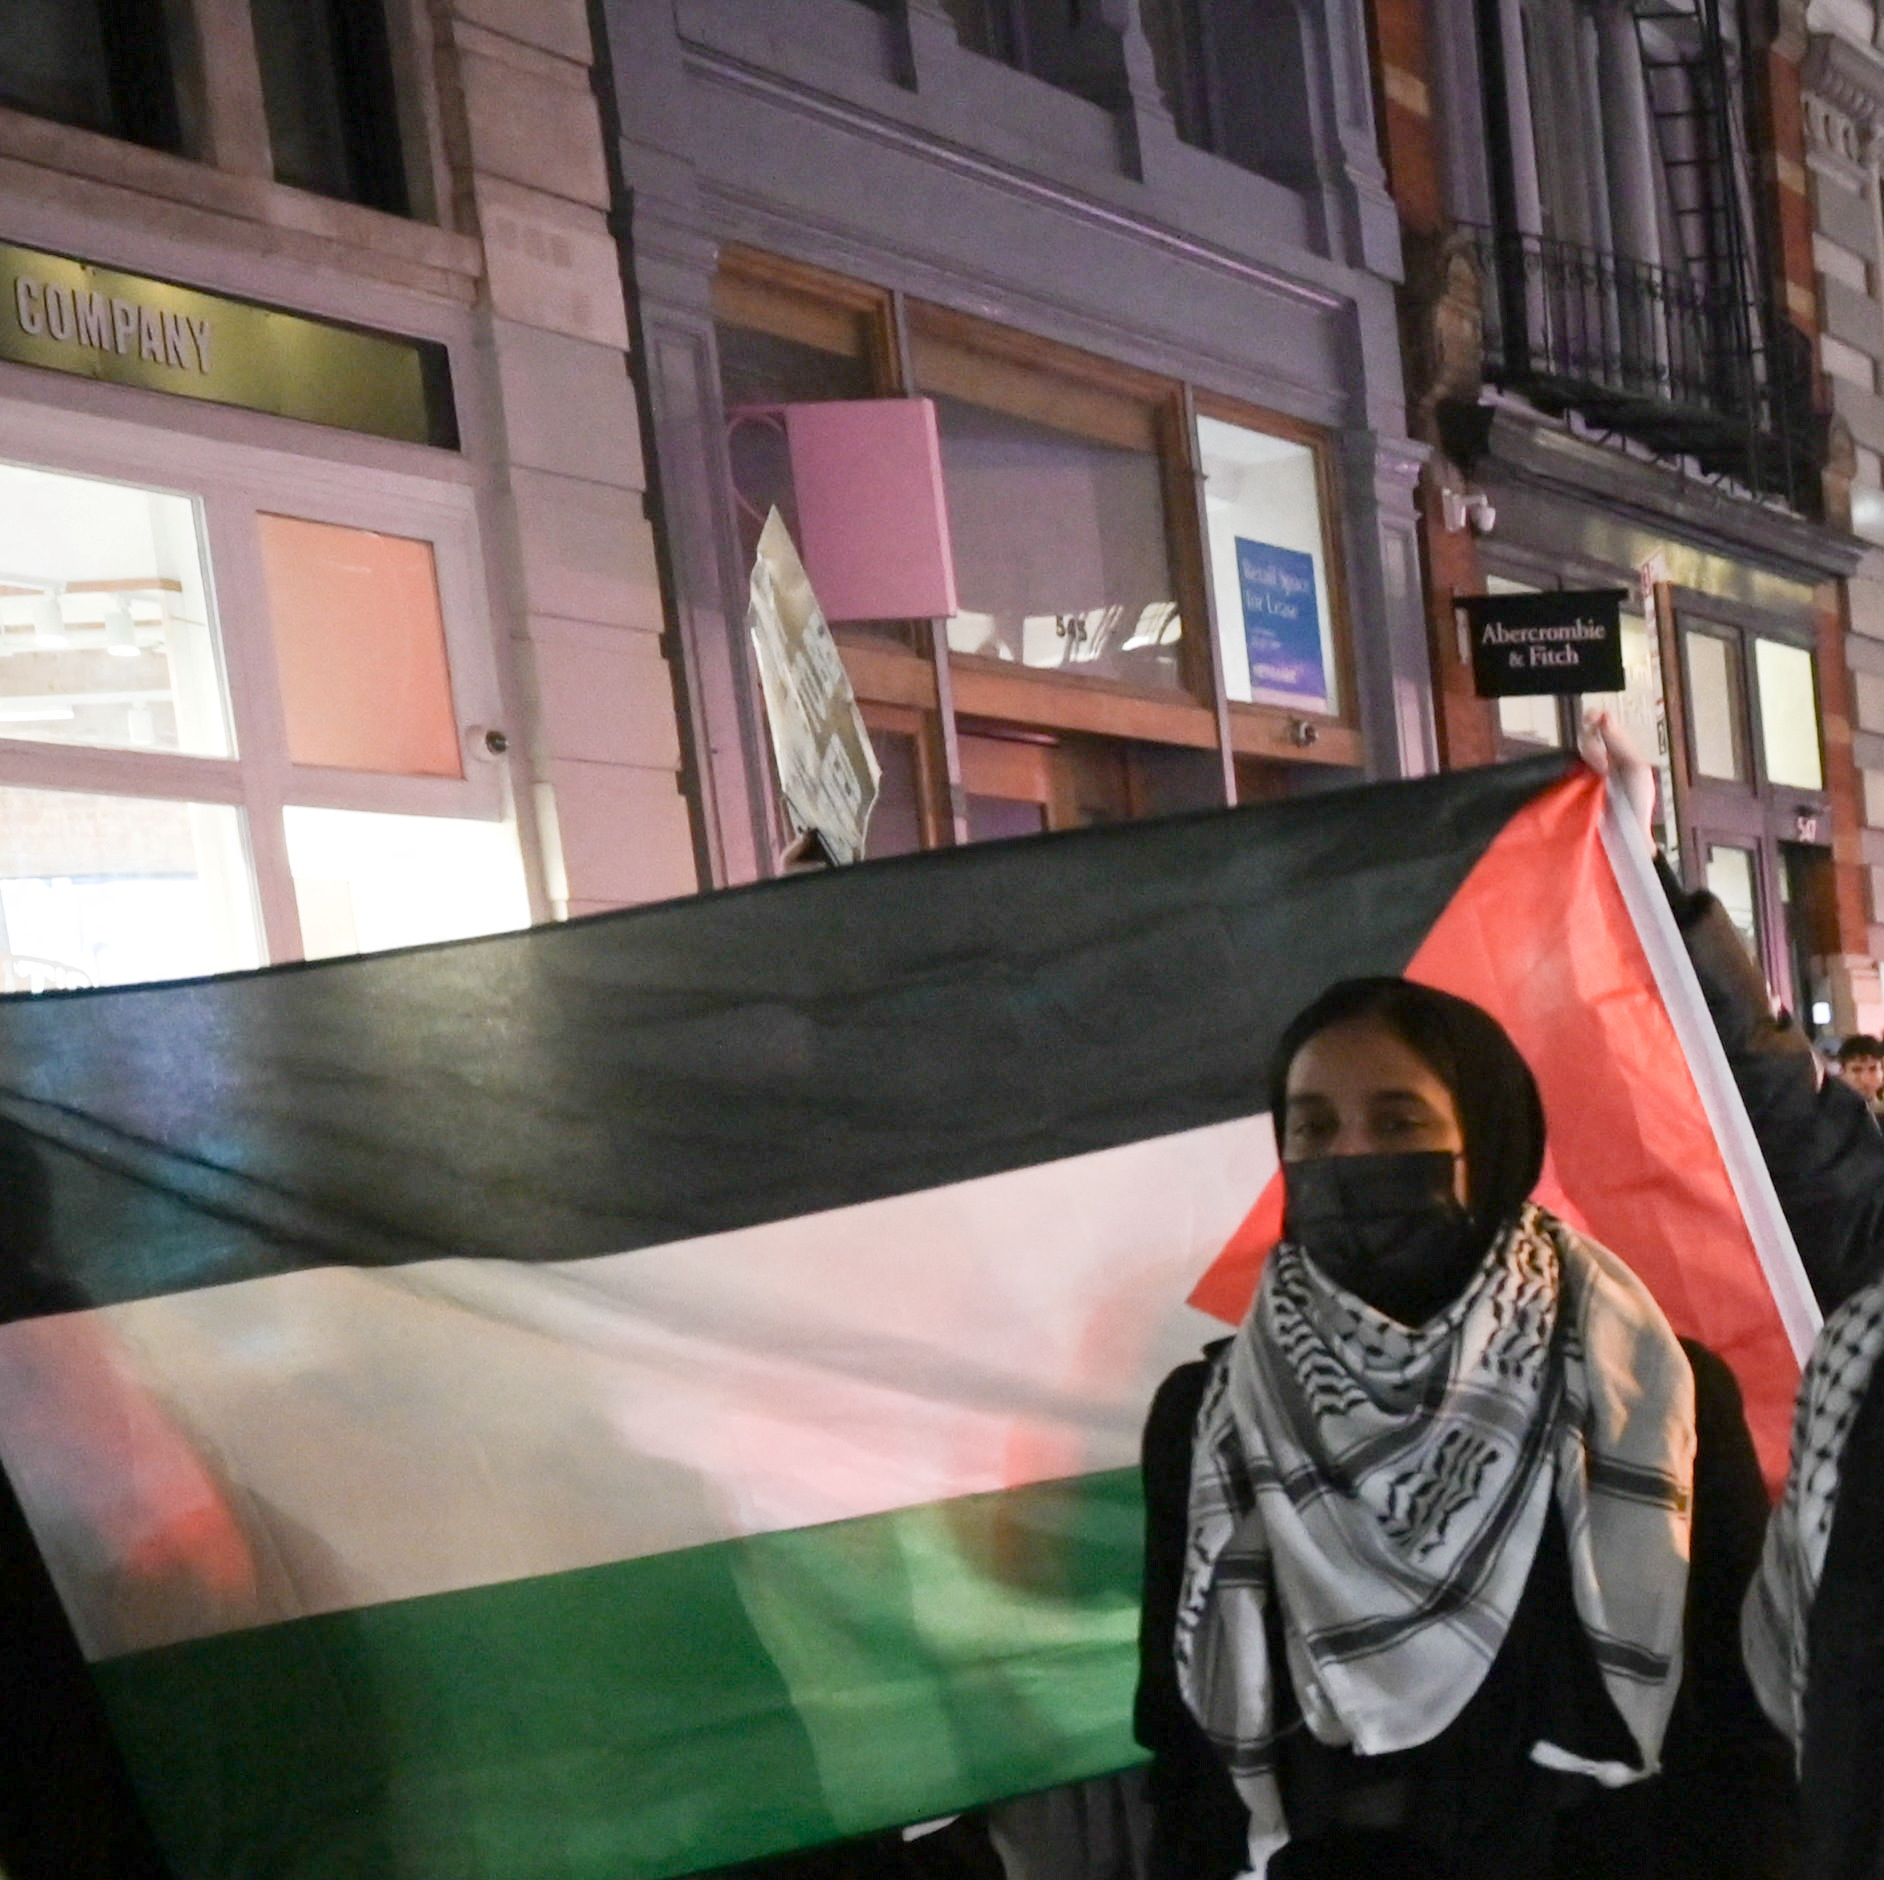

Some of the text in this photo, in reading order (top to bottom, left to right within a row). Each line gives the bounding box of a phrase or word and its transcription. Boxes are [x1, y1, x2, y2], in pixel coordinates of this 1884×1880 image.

[16, 274, 213, 373] COMPANY
[1482, 618, 1606, 645] Abercrombie
[1508, 645, 1580, 668] & Fitch
